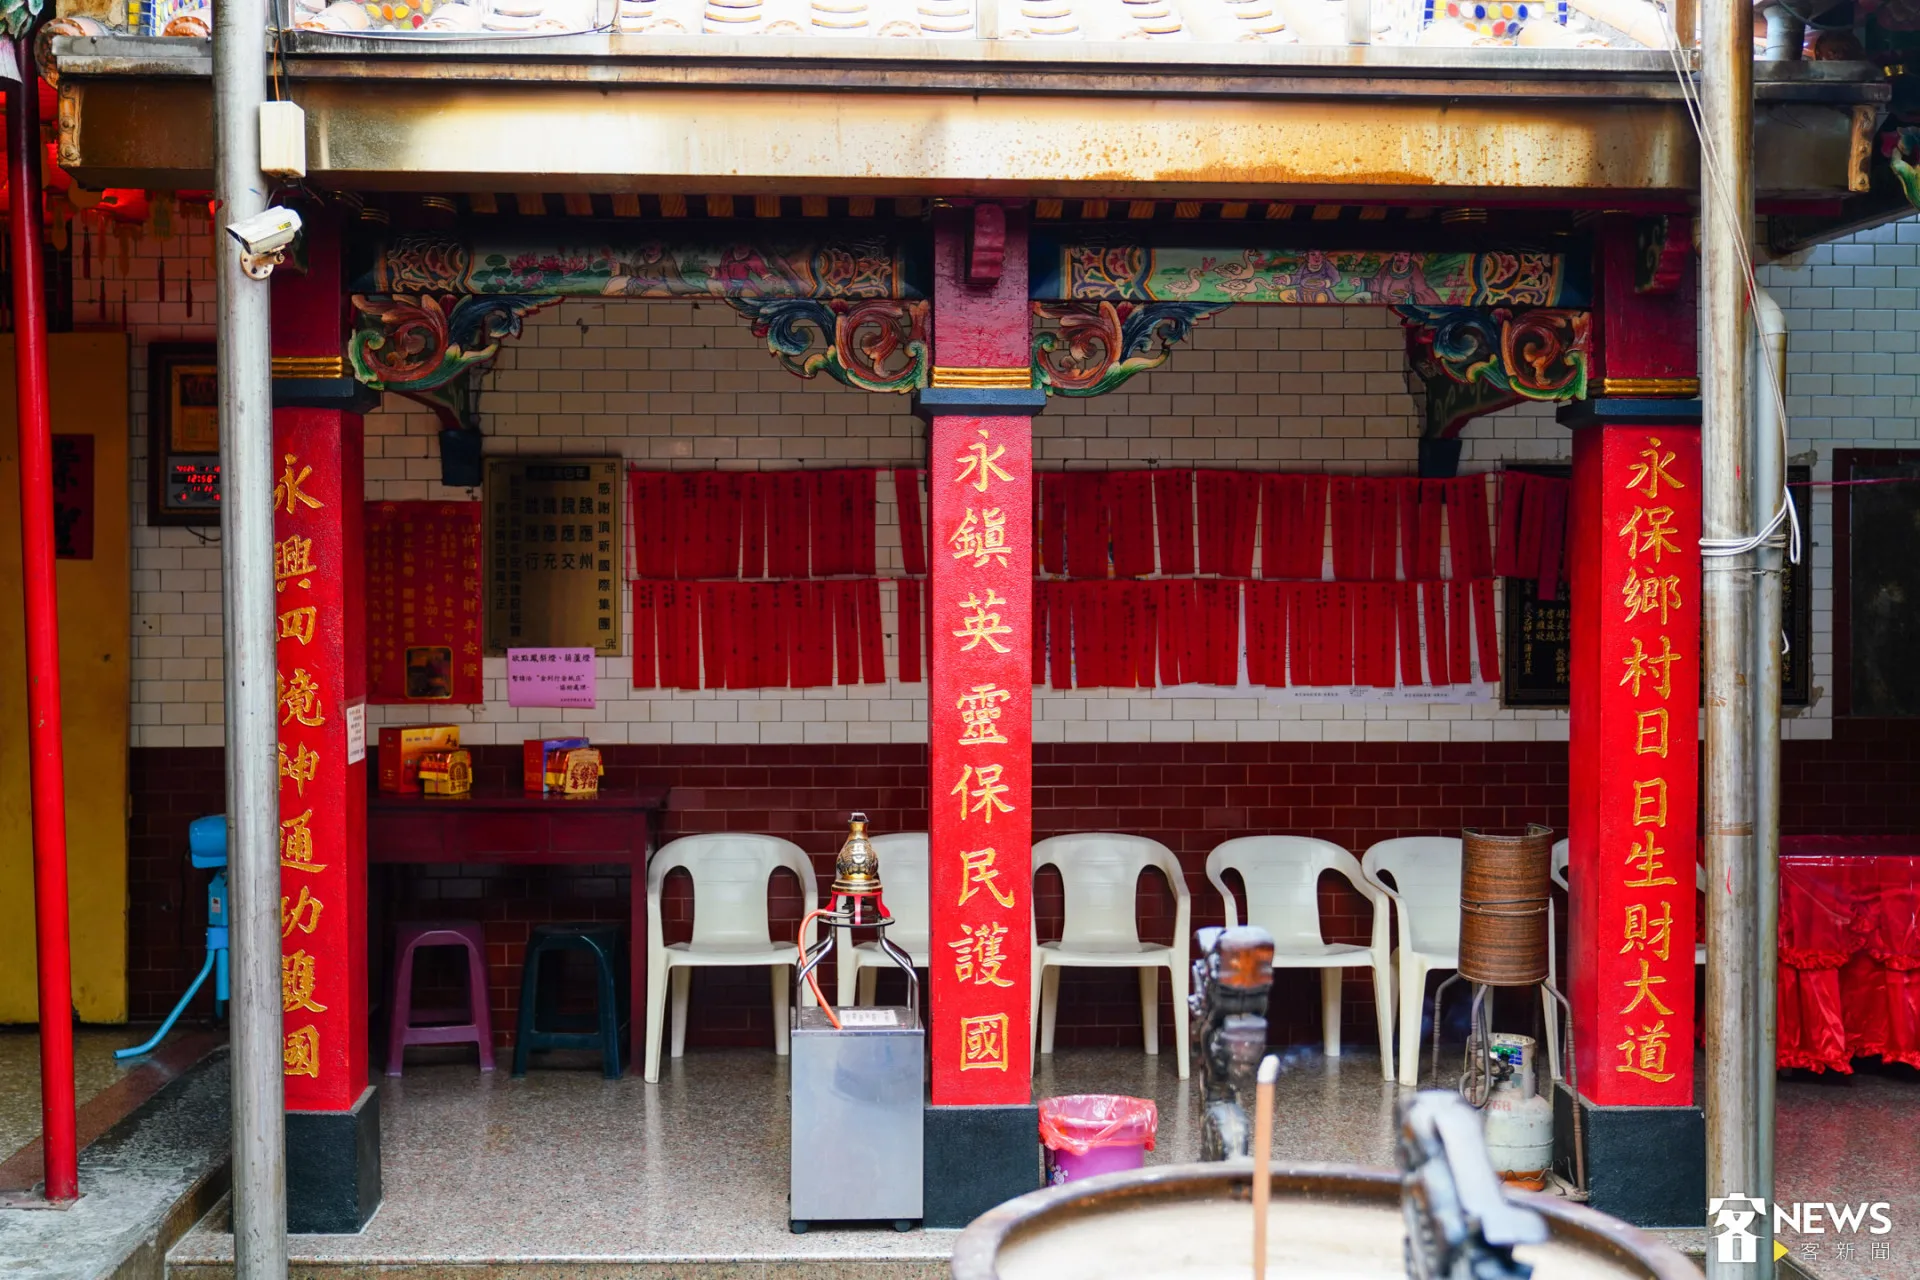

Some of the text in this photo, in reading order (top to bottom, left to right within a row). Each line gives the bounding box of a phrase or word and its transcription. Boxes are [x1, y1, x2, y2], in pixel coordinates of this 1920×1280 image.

[598, 482, 611, 630] 感謝頂新國際集團
[948, 429, 1015, 1073] 永鎮英靈保民護國
[1615, 437, 1685, 1083] 永保鄉村日日生財大道
